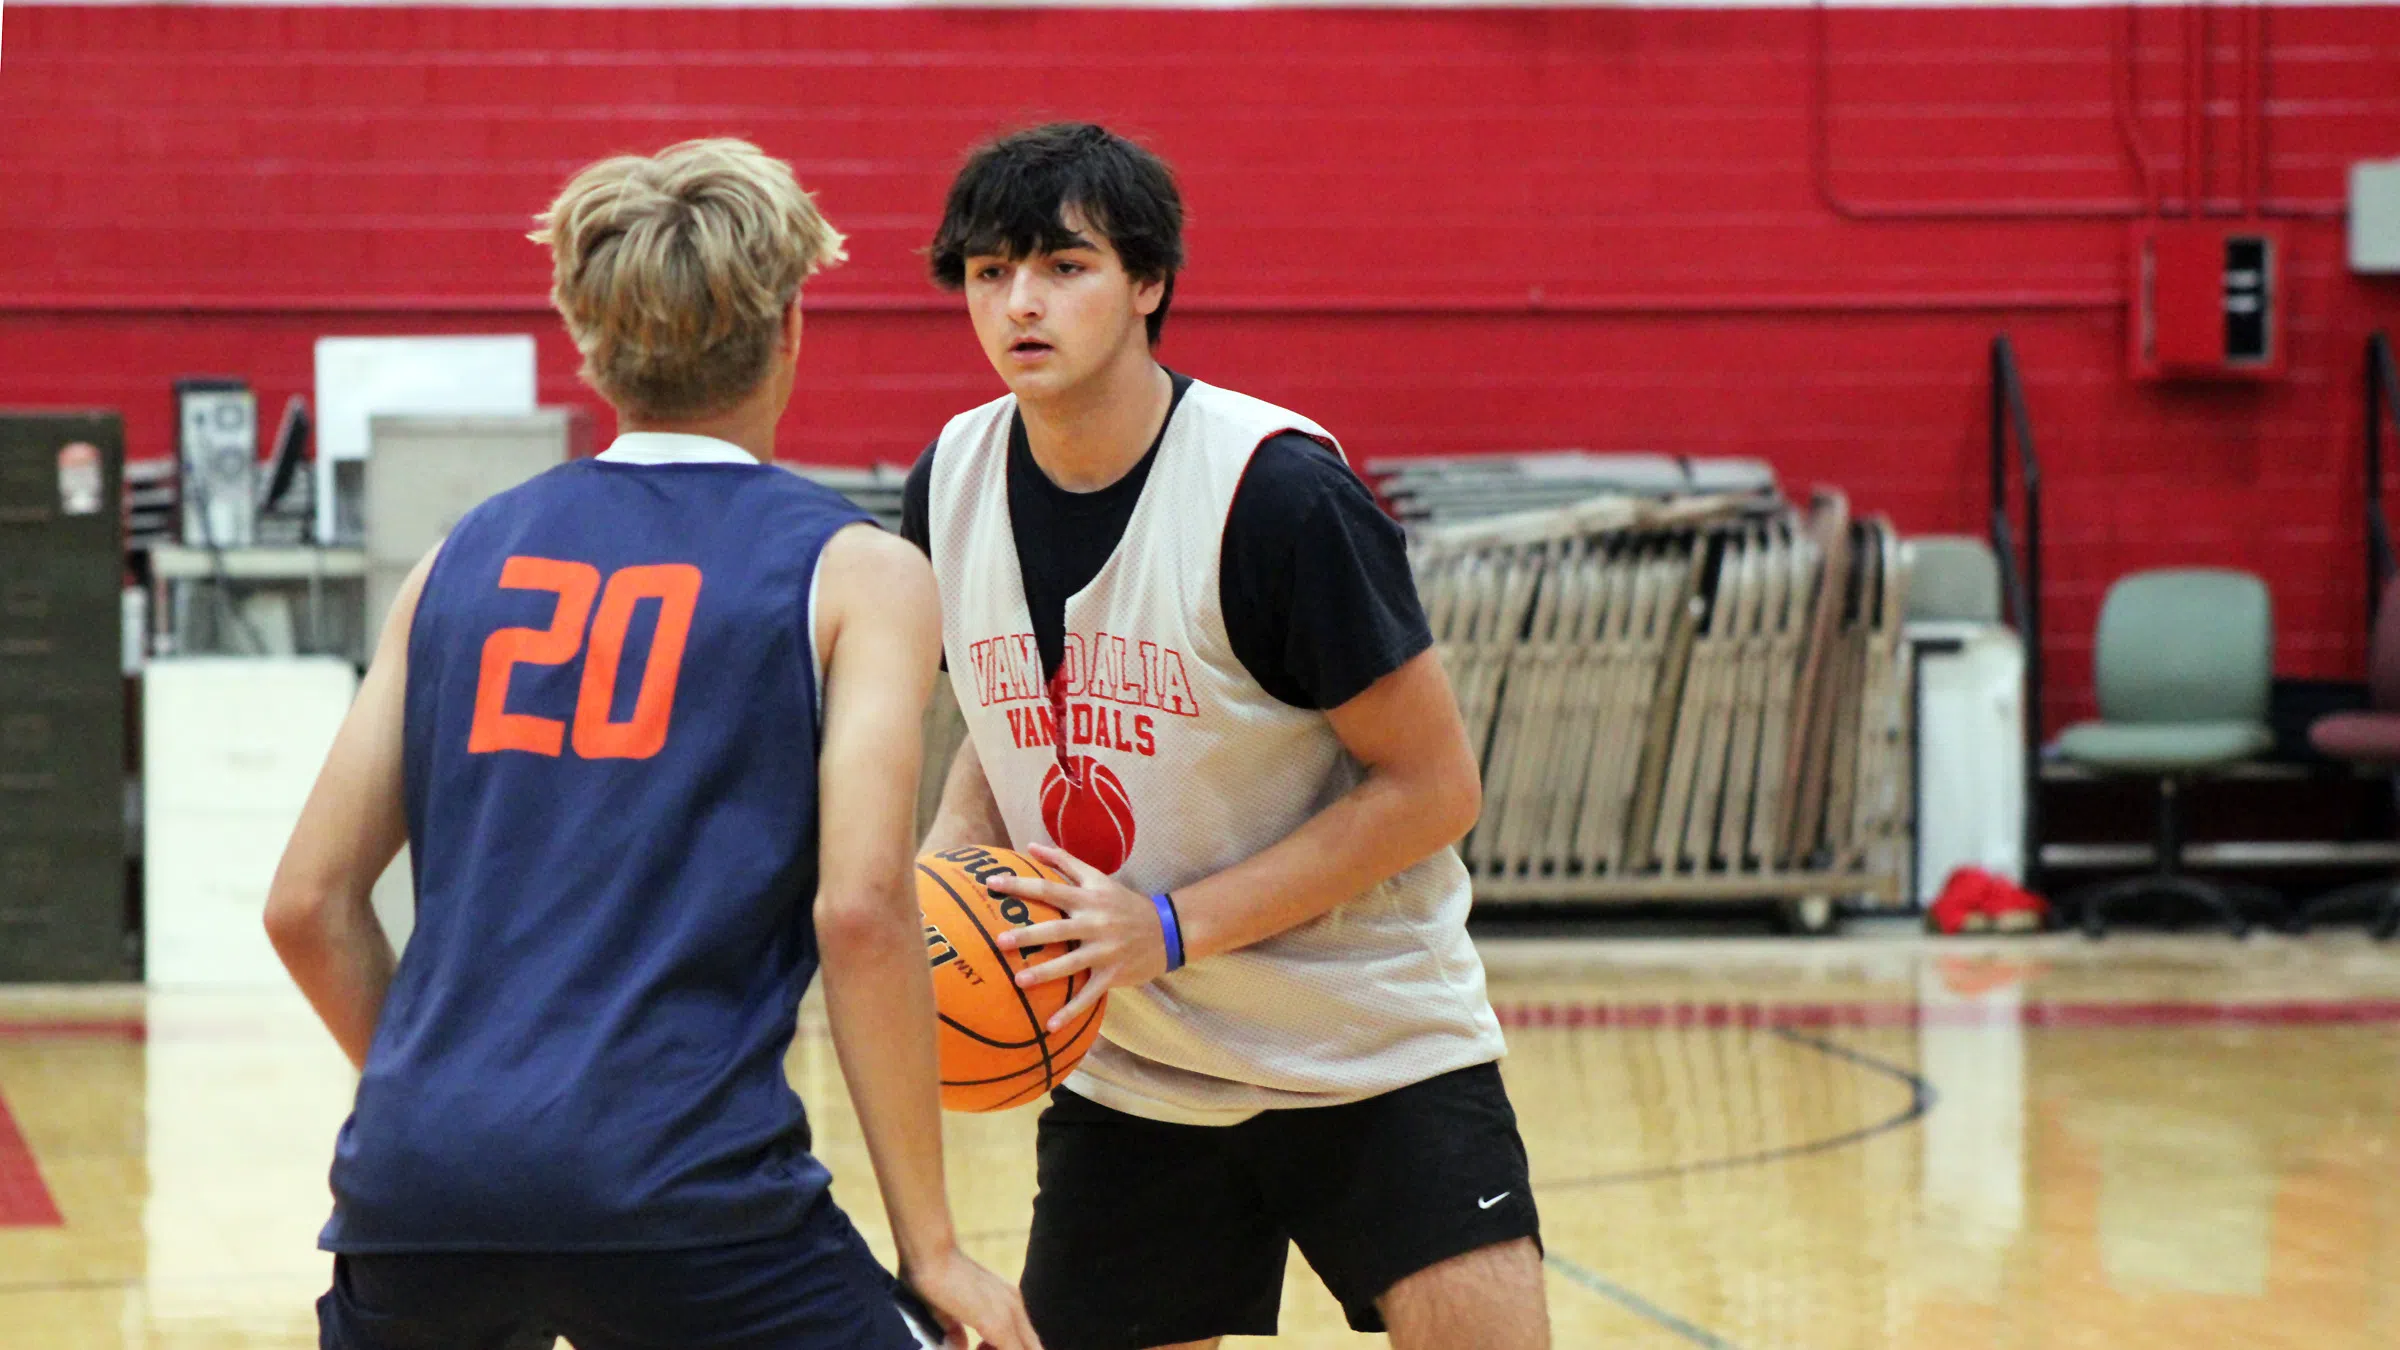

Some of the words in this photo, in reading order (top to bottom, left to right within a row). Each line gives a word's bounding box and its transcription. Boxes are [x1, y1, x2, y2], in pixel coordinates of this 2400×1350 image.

[467, 555, 702, 759] 20
[1006, 703, 1156, 757] VANDALS
[953, 959, 988, 986] NXT
